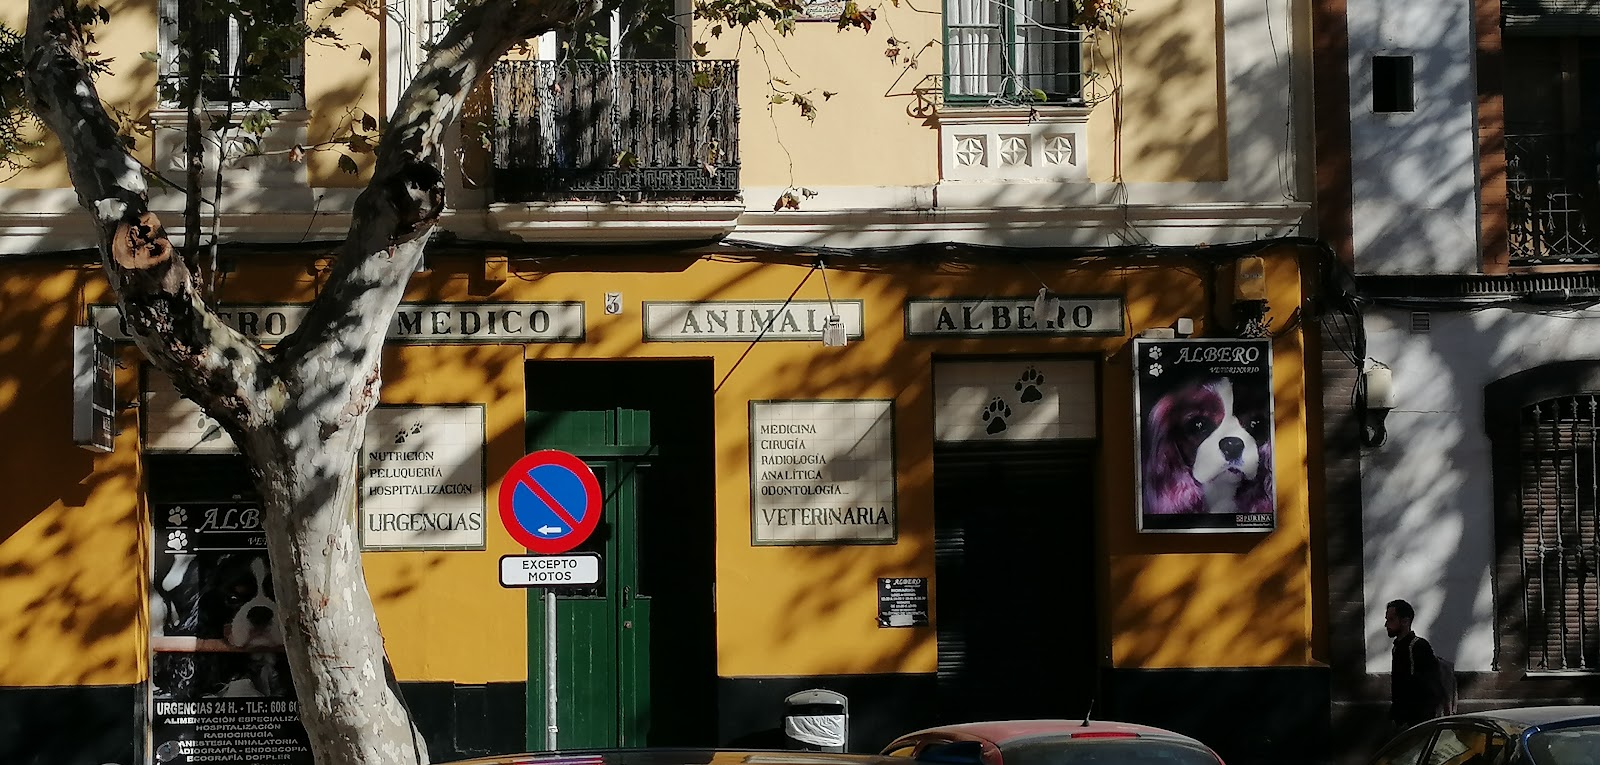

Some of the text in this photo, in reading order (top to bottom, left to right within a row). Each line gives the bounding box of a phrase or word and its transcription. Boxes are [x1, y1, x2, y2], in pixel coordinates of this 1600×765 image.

[606, 294, 620, 313] 3
[397, 310, 550, 335] MEDICO
[680, 309, 828, 334] ANIMAL
[1174, 346, 1260, 365] ALBERO
[760, 424, 817, 434] MEDICINA
[760, 437, 806, 450] CIRUGÍA
[761, 452, 827, 465] RADIOLOGÍA
[369, 465, 443, 478] PELUQUERÍA
[761, 468, 823, 481] ANALÍTICA
[199, 507, 261, 531] ALB
[368, 512, 481, 532] URGENCIAS
[762, 506, 890, 526] VETERINARIA
[522, 559, 578, 570] EXCEPTO
[528, 571, 572, 582] MOTOS
[156, 701, 213, 716] URGENCIAS
[214, 701, 226, 714] 24
[270, 700, 287, 713] 608
[163, 715, 300, 725] ALIMENTACIÓN ESPECIALIZA
[195, 723, 282, 732] HOSPITALIZACIÓN
[178, 740, 233, 748] ANESTESIA
[178, 746, 308, 755] ADIOGRAFÍA ENDOSCOPIA
[186, 753, 291, 763] ECOGRAFÍA DOPPLER
